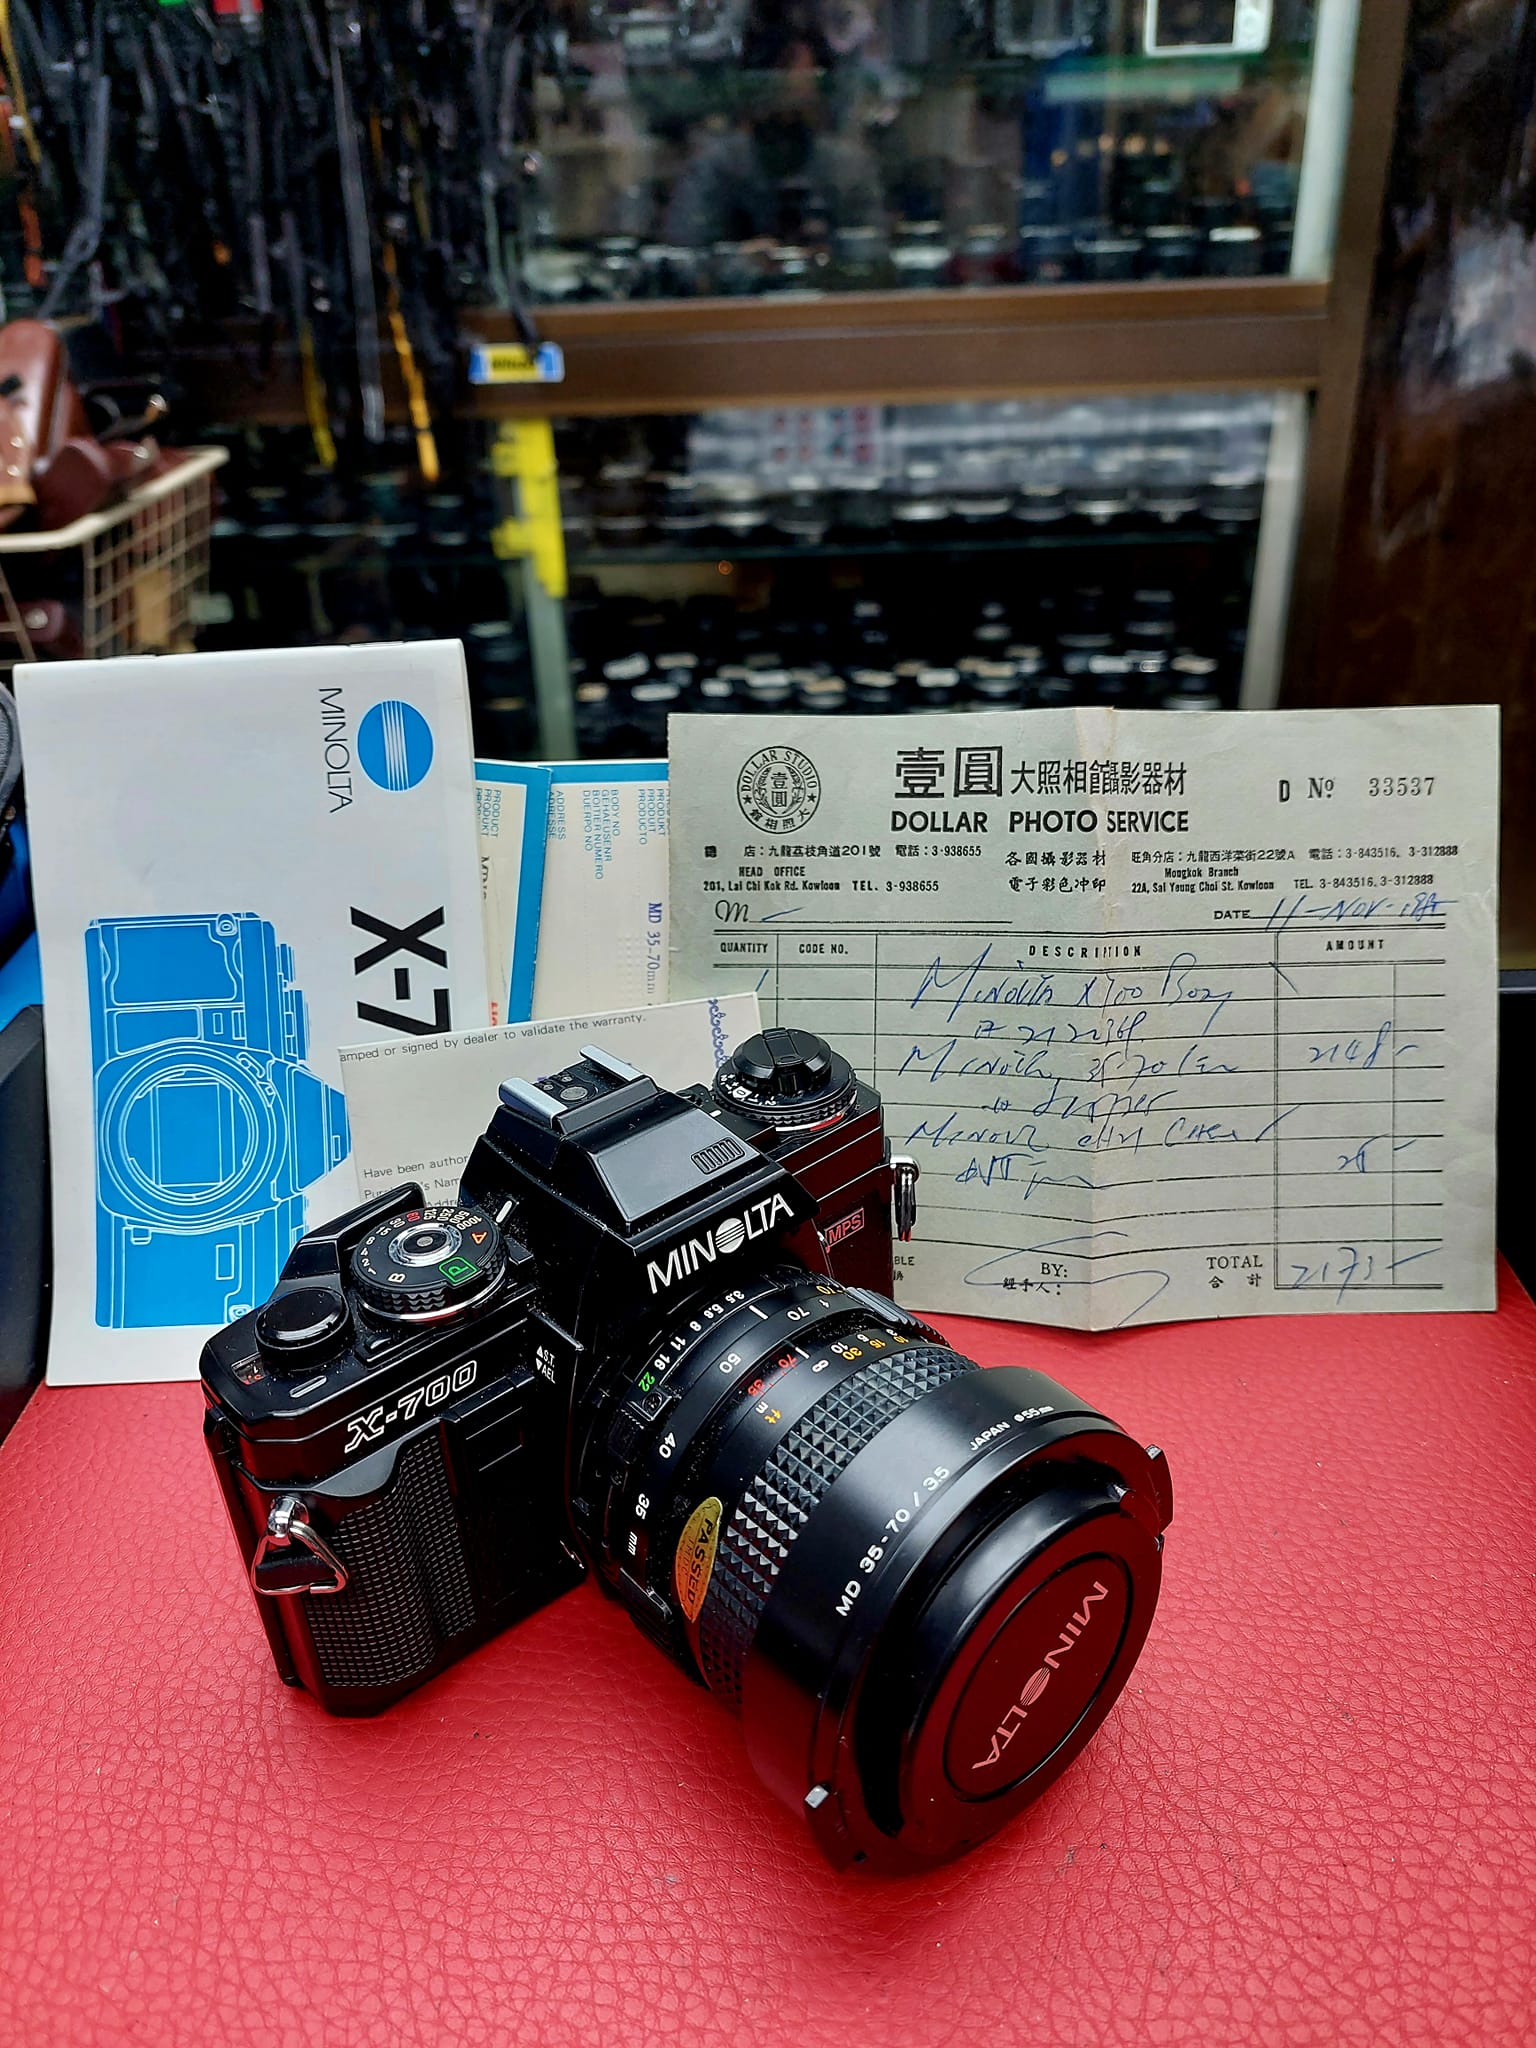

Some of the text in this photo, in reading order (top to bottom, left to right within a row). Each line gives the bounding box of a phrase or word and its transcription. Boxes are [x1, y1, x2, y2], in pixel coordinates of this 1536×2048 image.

[318, 687, 353, 813] MINOLTA
[741, 750, 818, 792] DOLLAR STUDIO
[894, 746, 1003, 799] 壹圓
[1279, 780, 1290, 802] D
[1369, 777, 1435, 797] 33537
[481, 788, 492, 836] PRODUKT
[490, 789, 502, 838] PRODUCT
[556, 790, 567, 840] ADDRESS
[610, 789, 621, 836] BODY NO
[638, 789, 648, 845] PRODUCTO
[647, 788, 656, 832] PRODUIT
[656, 788, 666, 836] PRODUKT
[891, 810, 1190, 833] DOLLAR PHOTO SERVICE
[585, 835, 593, 851] NO
[594, 834, 604, 879] NUMERO
[738, 866, 806, 877] HEAD OFFICE
[1208, 866, 1239, 877] Branch
[728, 880, 743, 891] Lai
[746, 880, 761, 891] Chi
[764, 880, 781, 891] Kok
[784, 880, 799, 891] Rd.
[852, 880, 879, 891] TEL.
[885, 880, 939, 892] 3-938655
[1152, 882, 1167, 893] Sai
[1199, 881, 1218, 892] Choi
[1221, 880, 1234, 892] St.
[1294, 878, 1313, 890] TEL.
[648, 902, 662, 923] MD
[1213, 910, 1251, 920] DATE
[720, 942, 769, 953] QUANTITY
[799, 943, 825, 954] CODE
[830, 944, 849, 954] NO.
[1325, 939, 1385, 951] AMOUNT
[384, 1047, 396, 1056] or
[402, 1039, 439, 1055] signed
[444, 1038, 459, 1049] by
[463, 1032, 499, 1046] dealer
[504, 1031, 517, 1040] to
[521, 1024, 566, 1037] validate
[569, 1020, 589, 1031] the
[592, 1013, 647, 1028] warranty.
[363, 1167, 393, 1178] Have
[398, 1162, 425, 1175] been
[389, 1217, 406, 1229] 30
[423, 1208, 438, 1220] 125
[437, 1208, 455, 1222] 250
[449, 1210, 470, 1224] 500
[455, 1215, 483, 1231] 1000
[375, 1226, 392, 1236] 15
[828, 1212, 863, 1241] MPS
[365, 1236, 376, 1245] 8
[471, 1231, 488, 1244] A
[646, 1192, 795, 1294] MINOLTA
[362, 1258, 371, 1268] 2
[1040, 1262, 1068, 1278] BY:
[1206, 1256, 1263, 1270] TOTAL
[387, 1272, 406, 1283] B
[787, 1307, 810, 1321] 70
[689, 1320, 702, 1332] 8
[670, 1336, 686, 1351] 11
[830, 1342, 849, 1354] 10
[654, 1353, 671, 1371] 16
[778, 1354, 798, 1369] 70
[842, 1347, 863, 1361] 30
[719, 1353, 742, 1374] 50
[541, 1364, 556, 1384] AEL
[638, 1371, 656, 1392] 22
[344, 1359, 478, 1453] X-700
[755, 1401, 769, 1414] m
[764, 1407, 784, 1426] ft
[659, 1432, 677, 1459] 40
[635, 1493, 650, 1520] 35
[835, 1580, 861, 1617] MD
[922, 1466, 950, 1492] 3.5
[969, 1421, 1011, 1451] JAPAN
[687, 1518, 715, 1605] PASSED
[971, 1581, 1109, 1770] MINOLTA
